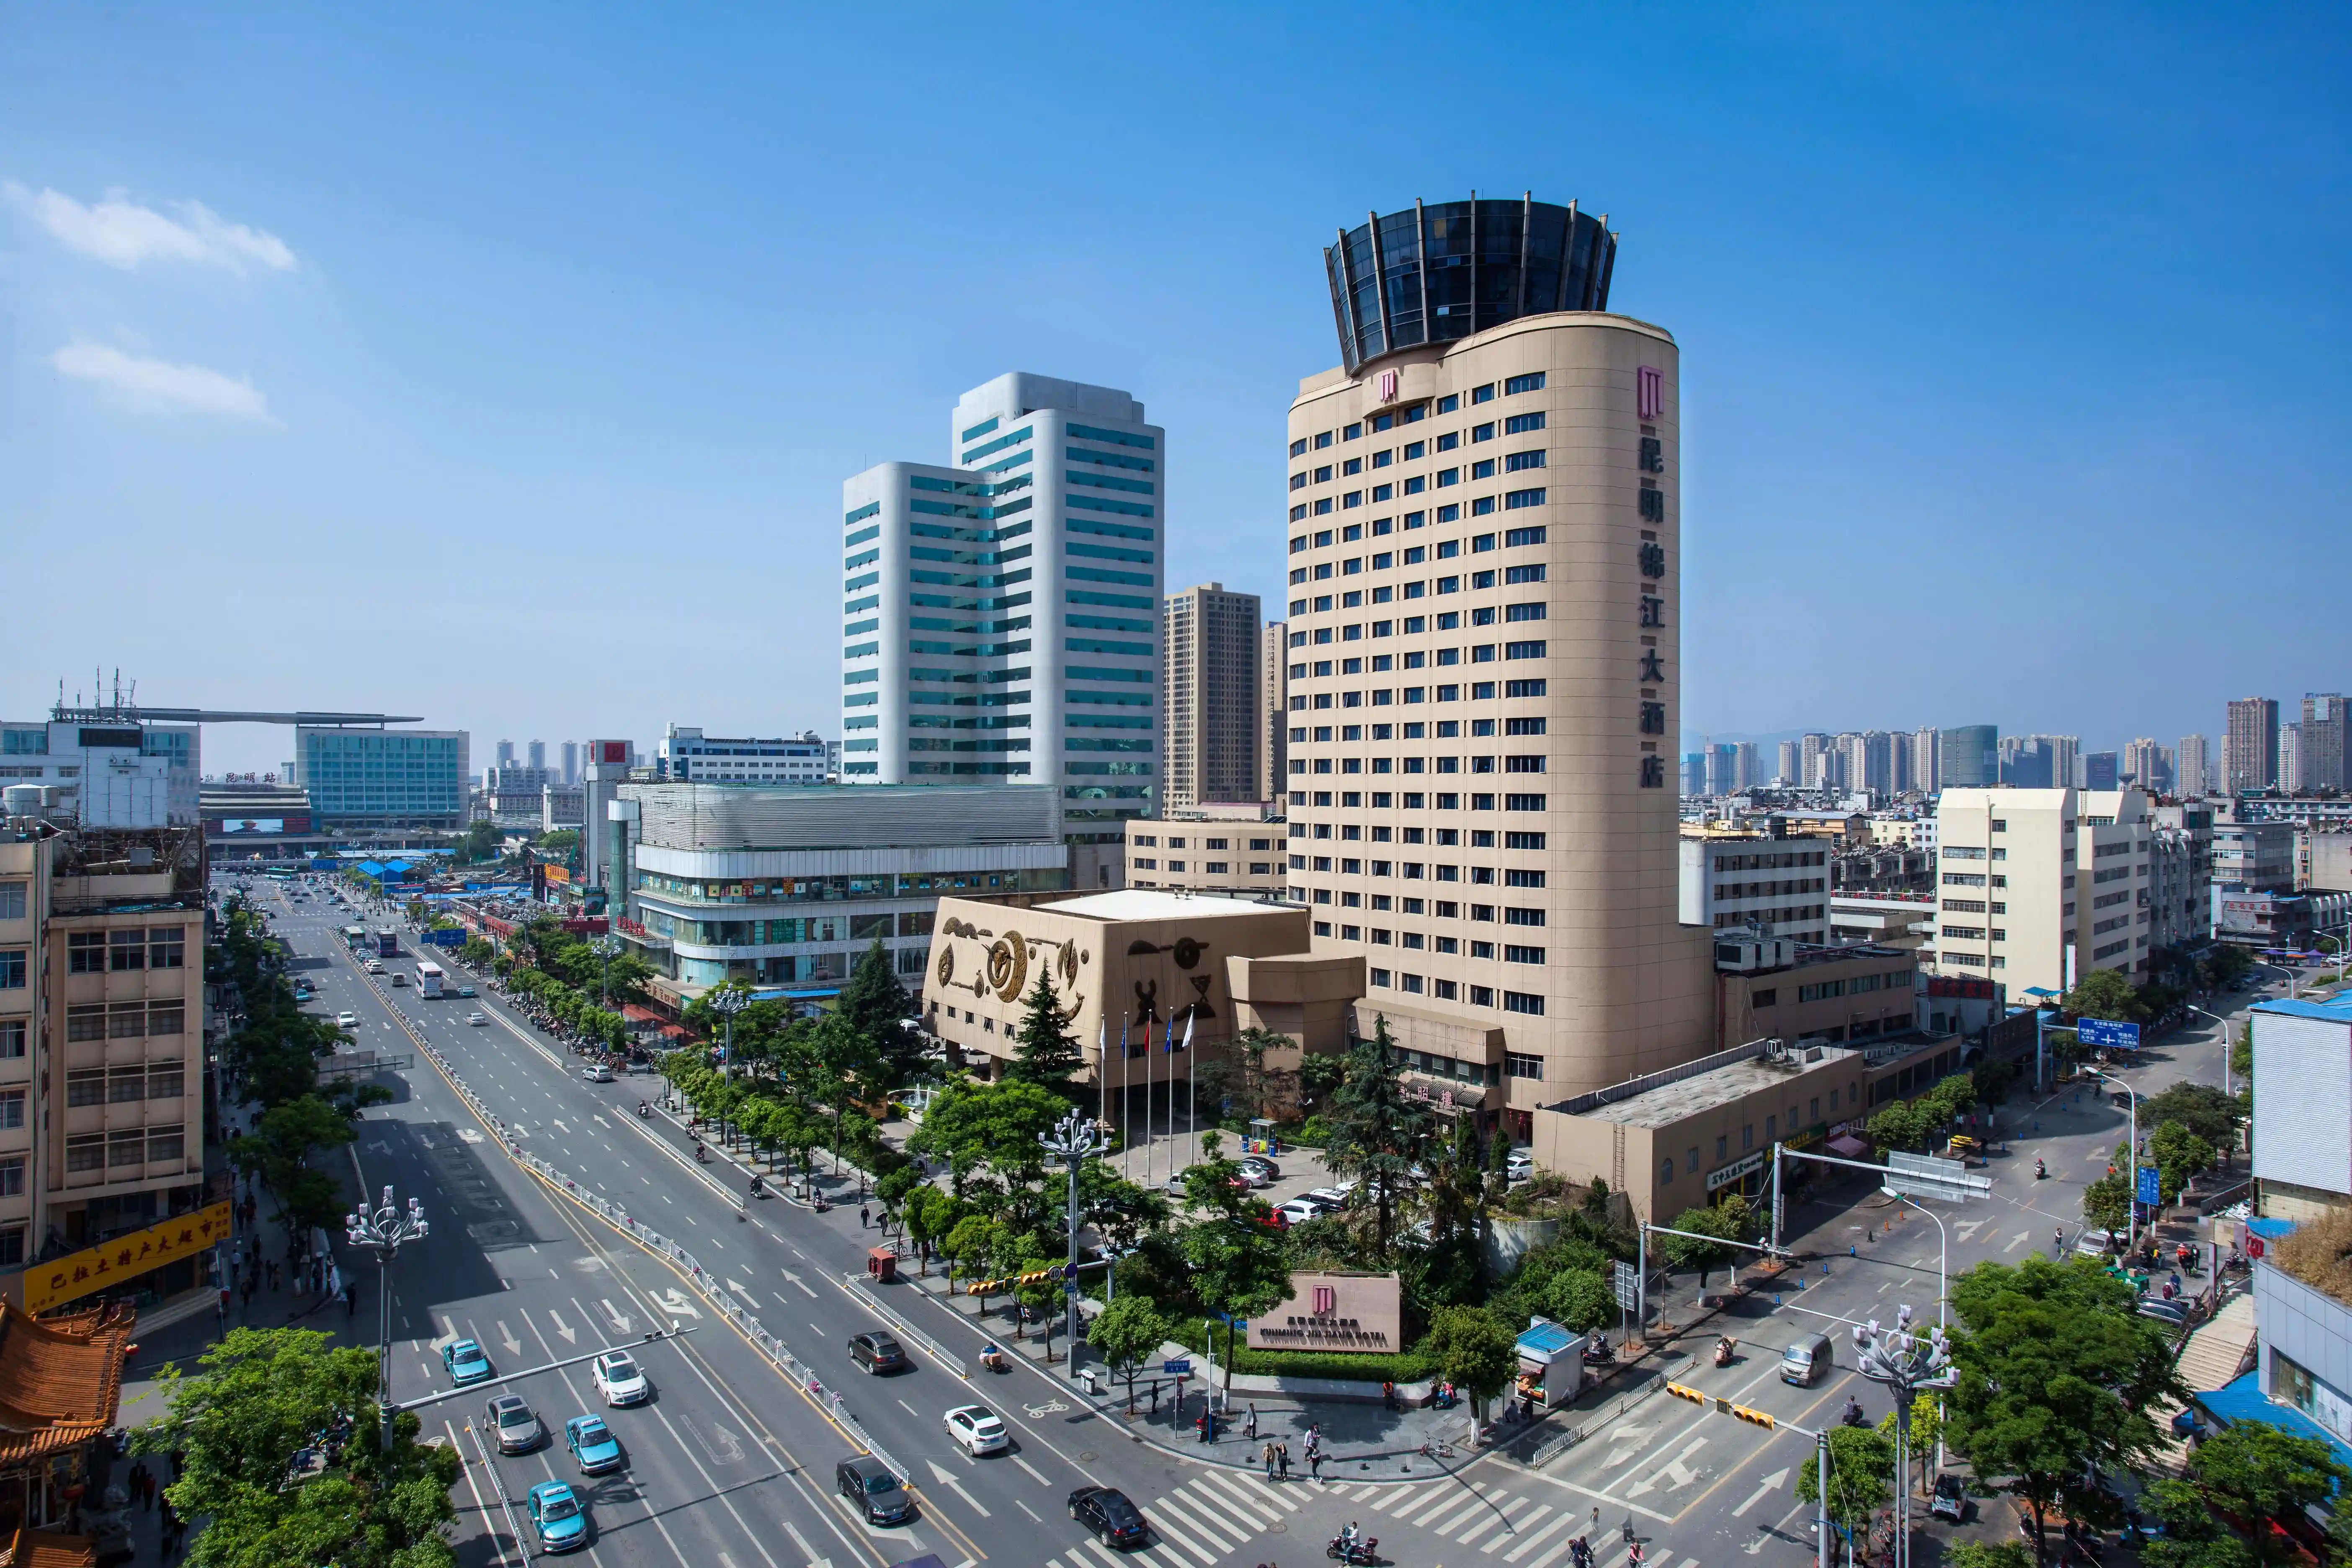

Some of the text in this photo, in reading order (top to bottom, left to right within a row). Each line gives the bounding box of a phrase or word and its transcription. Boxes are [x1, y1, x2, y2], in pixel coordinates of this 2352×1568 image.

[1640, 436, 1665, 788] 昆明锦江大酒店
[226, 772, 276, 782] 昆明站
[729, 942, 844, 958] 云南锦华国际酒店
[1050, 1270, 1060, 1278] 40
[1287, 1316, 1357, 1326] 昆明锦江大酒店
[1260, 1328, 1386, 1341] KUNMING JIN JIANG HOTEL
